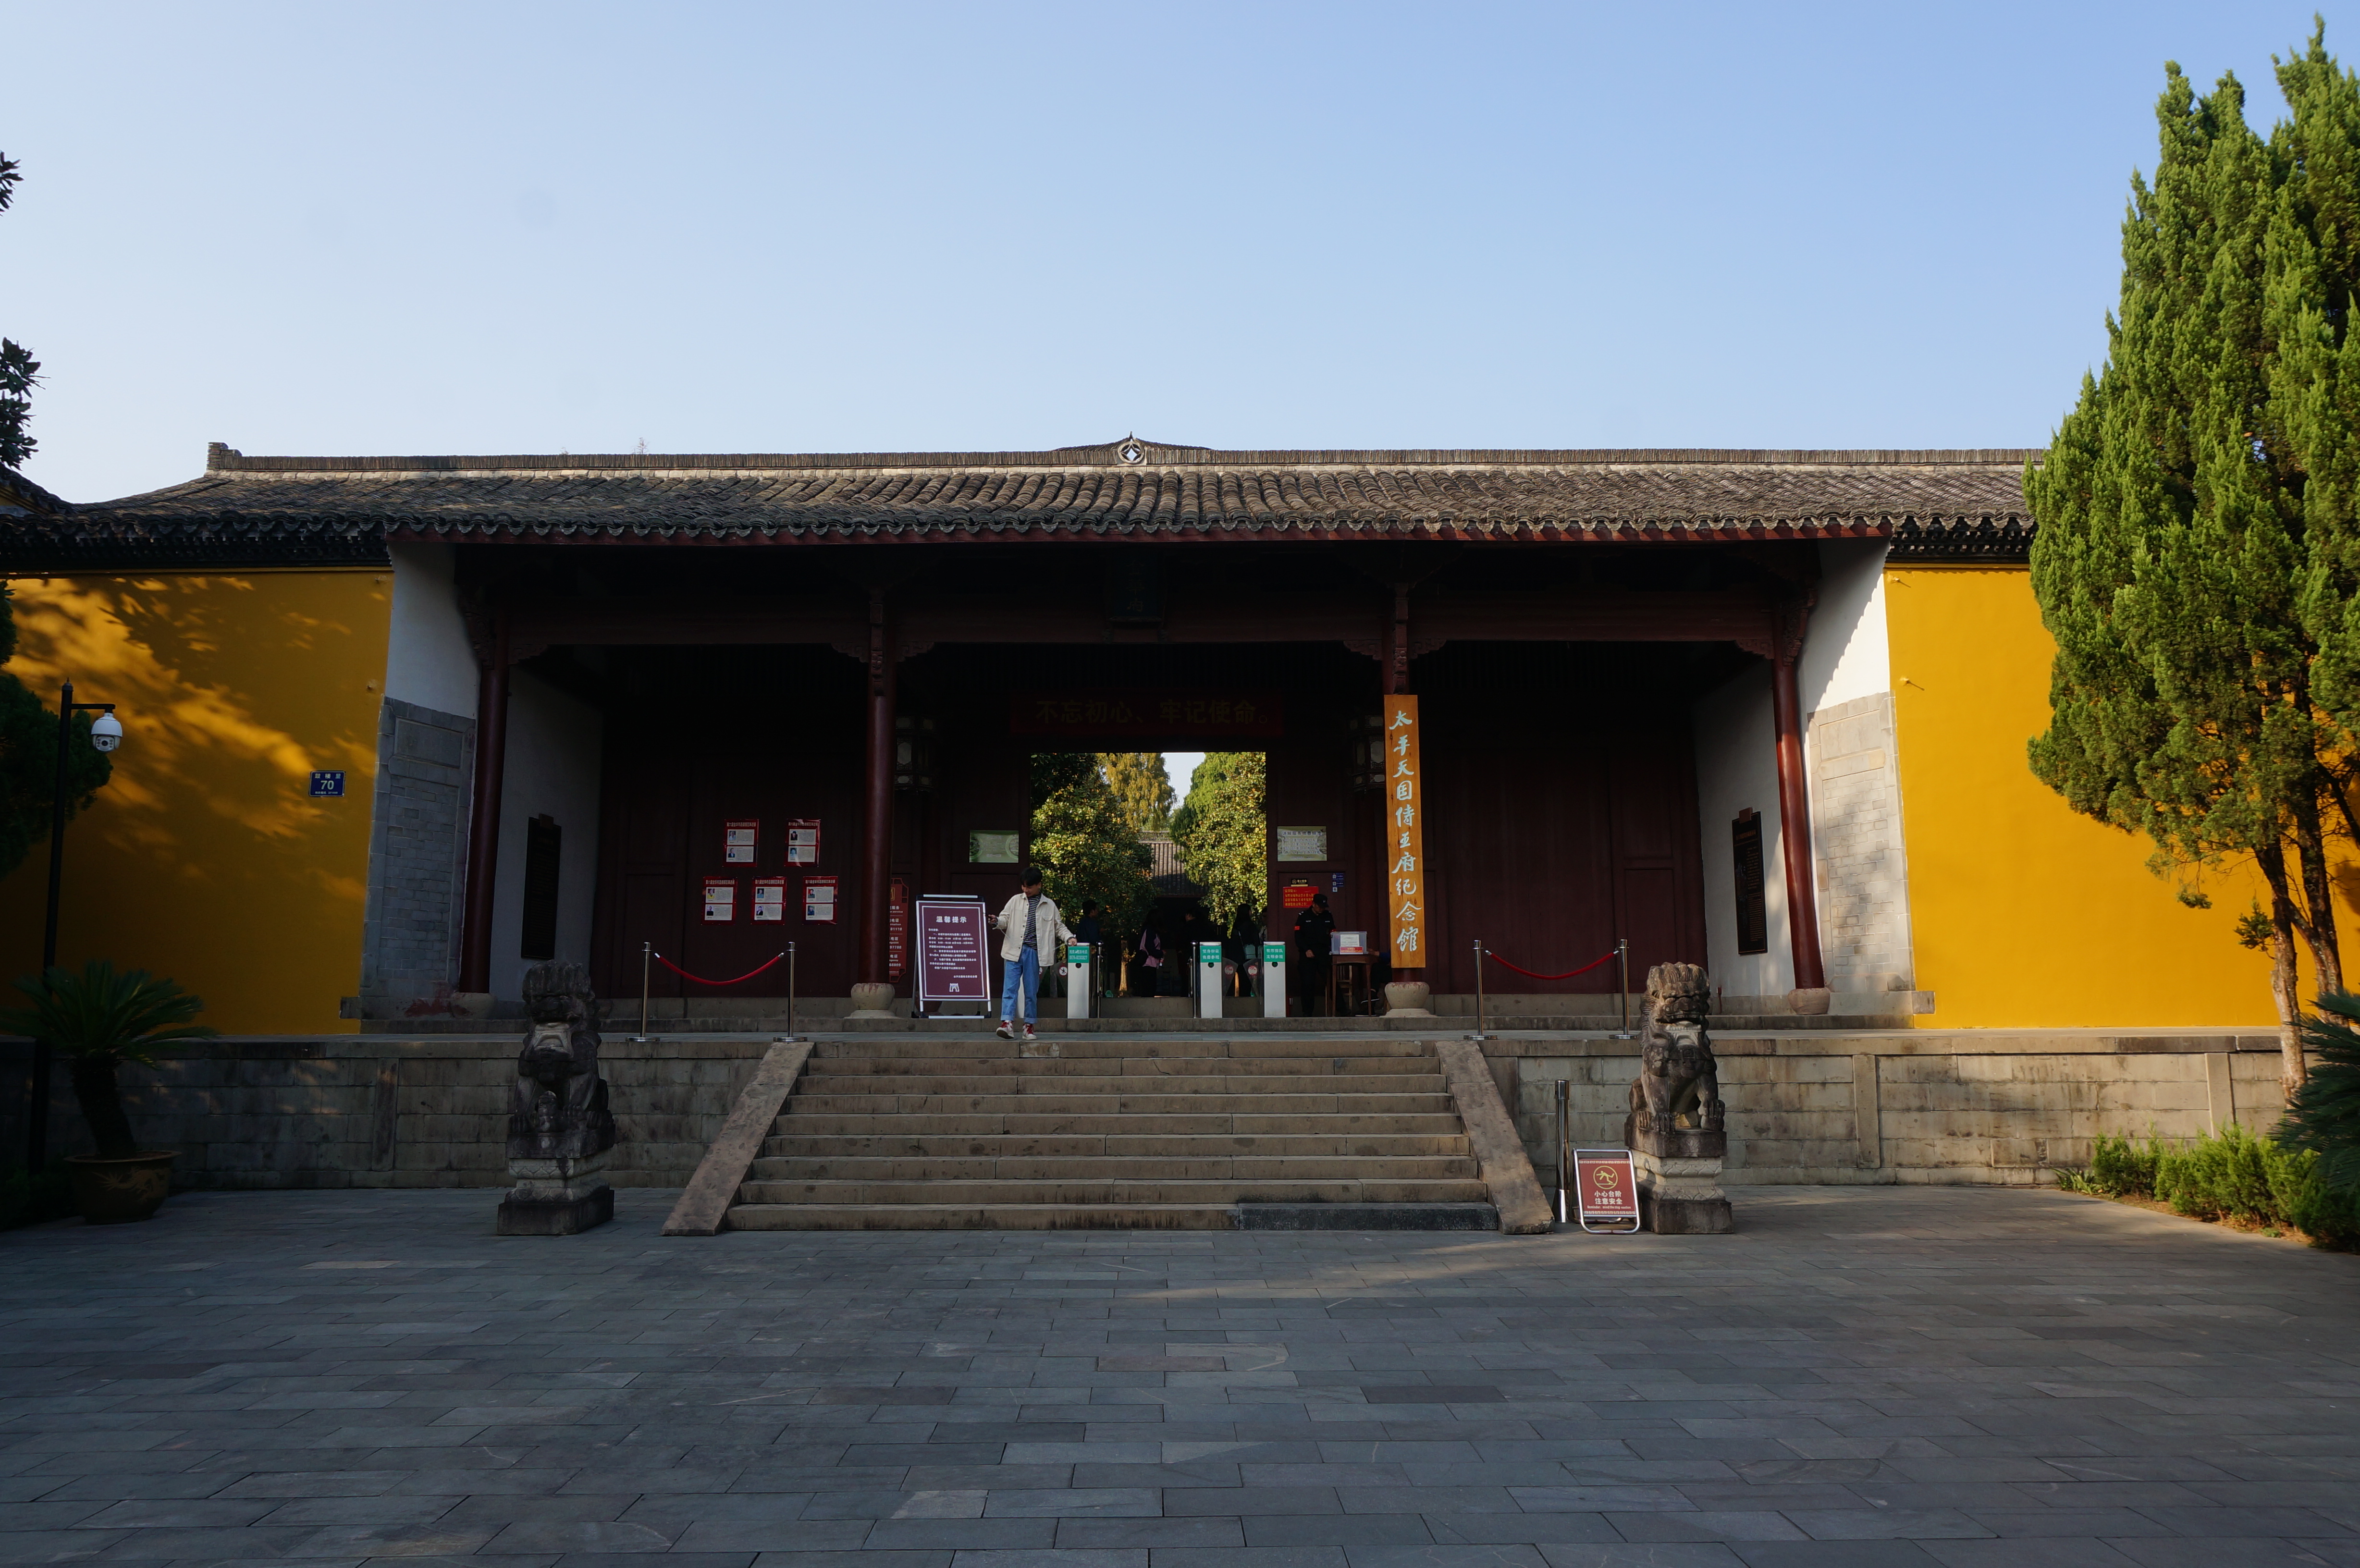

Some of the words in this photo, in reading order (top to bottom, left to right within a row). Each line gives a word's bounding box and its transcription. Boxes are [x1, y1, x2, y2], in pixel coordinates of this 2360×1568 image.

[1035, 699, 1143, 724] 不忘初心、
[1159, 699, 1267, 724] 牢记使命。
[320, 780, 334, 790] 70
